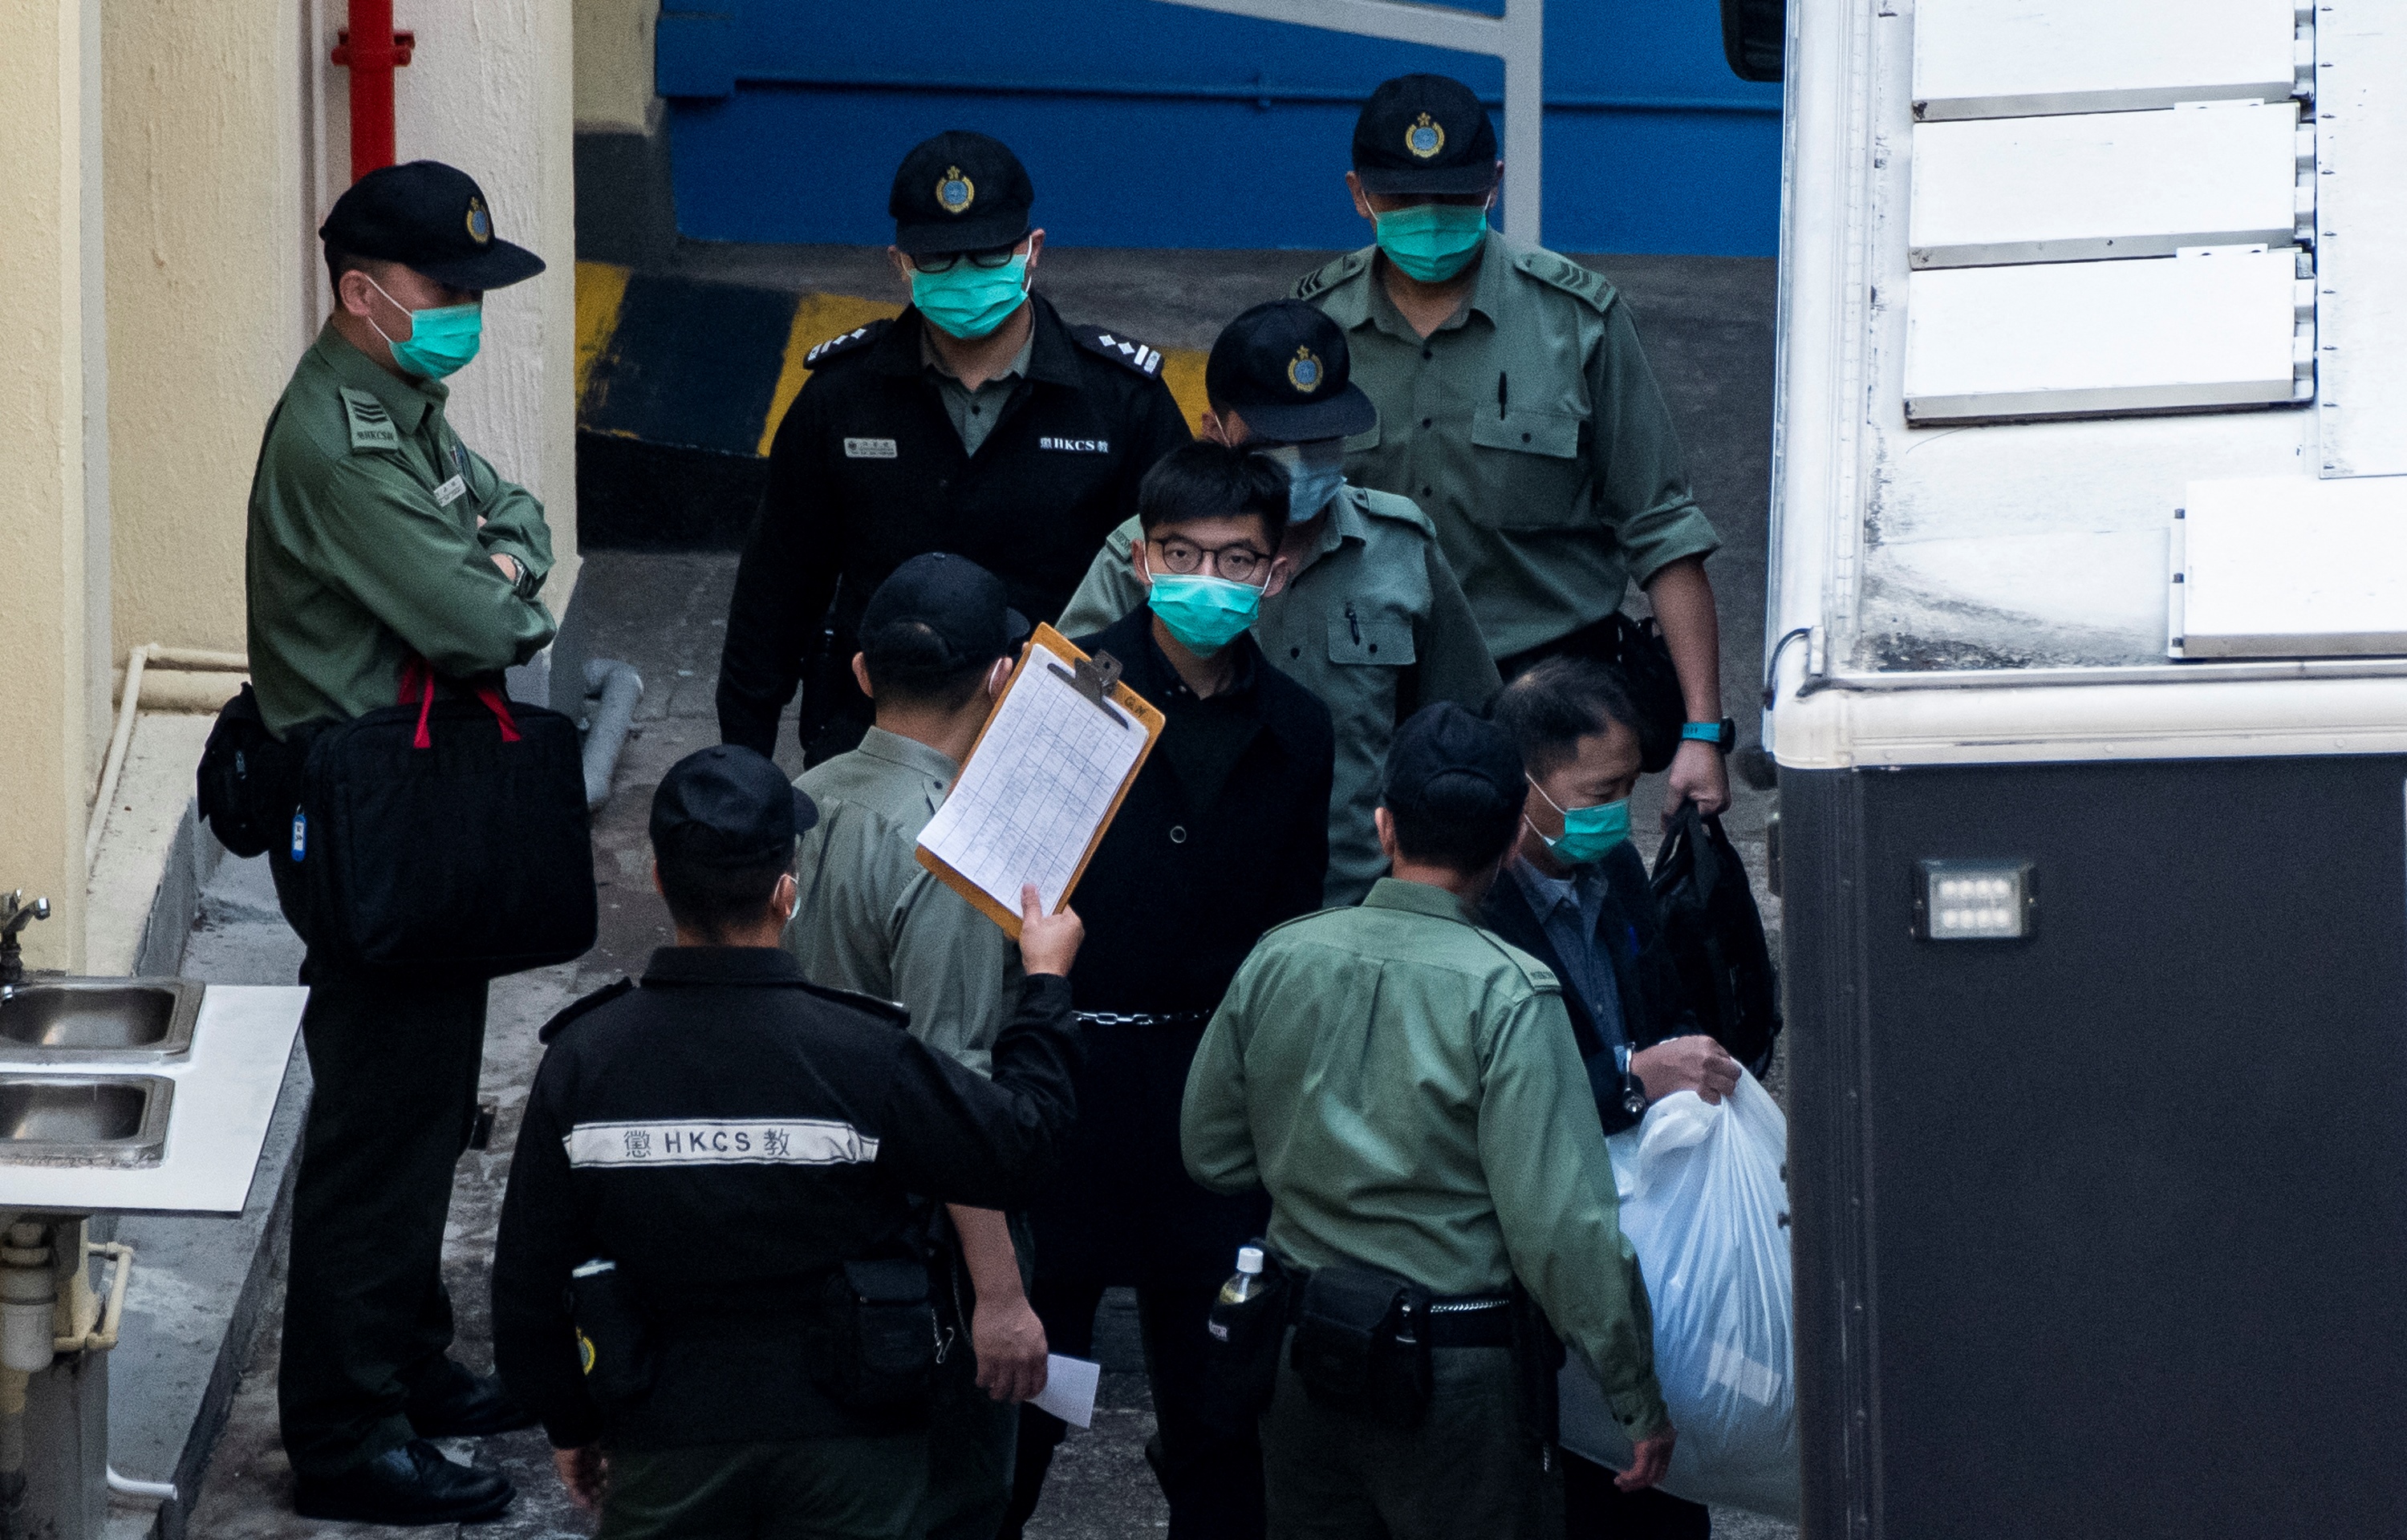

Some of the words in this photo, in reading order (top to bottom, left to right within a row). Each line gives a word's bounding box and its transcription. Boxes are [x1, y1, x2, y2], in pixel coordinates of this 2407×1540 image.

[1053, 437, 1095, 451] HKCS
[623, 1129, 651, 1158] 懲
[664, 1131, 751, 1153] HKCS
[763, 1128, 790, 1156] 教
